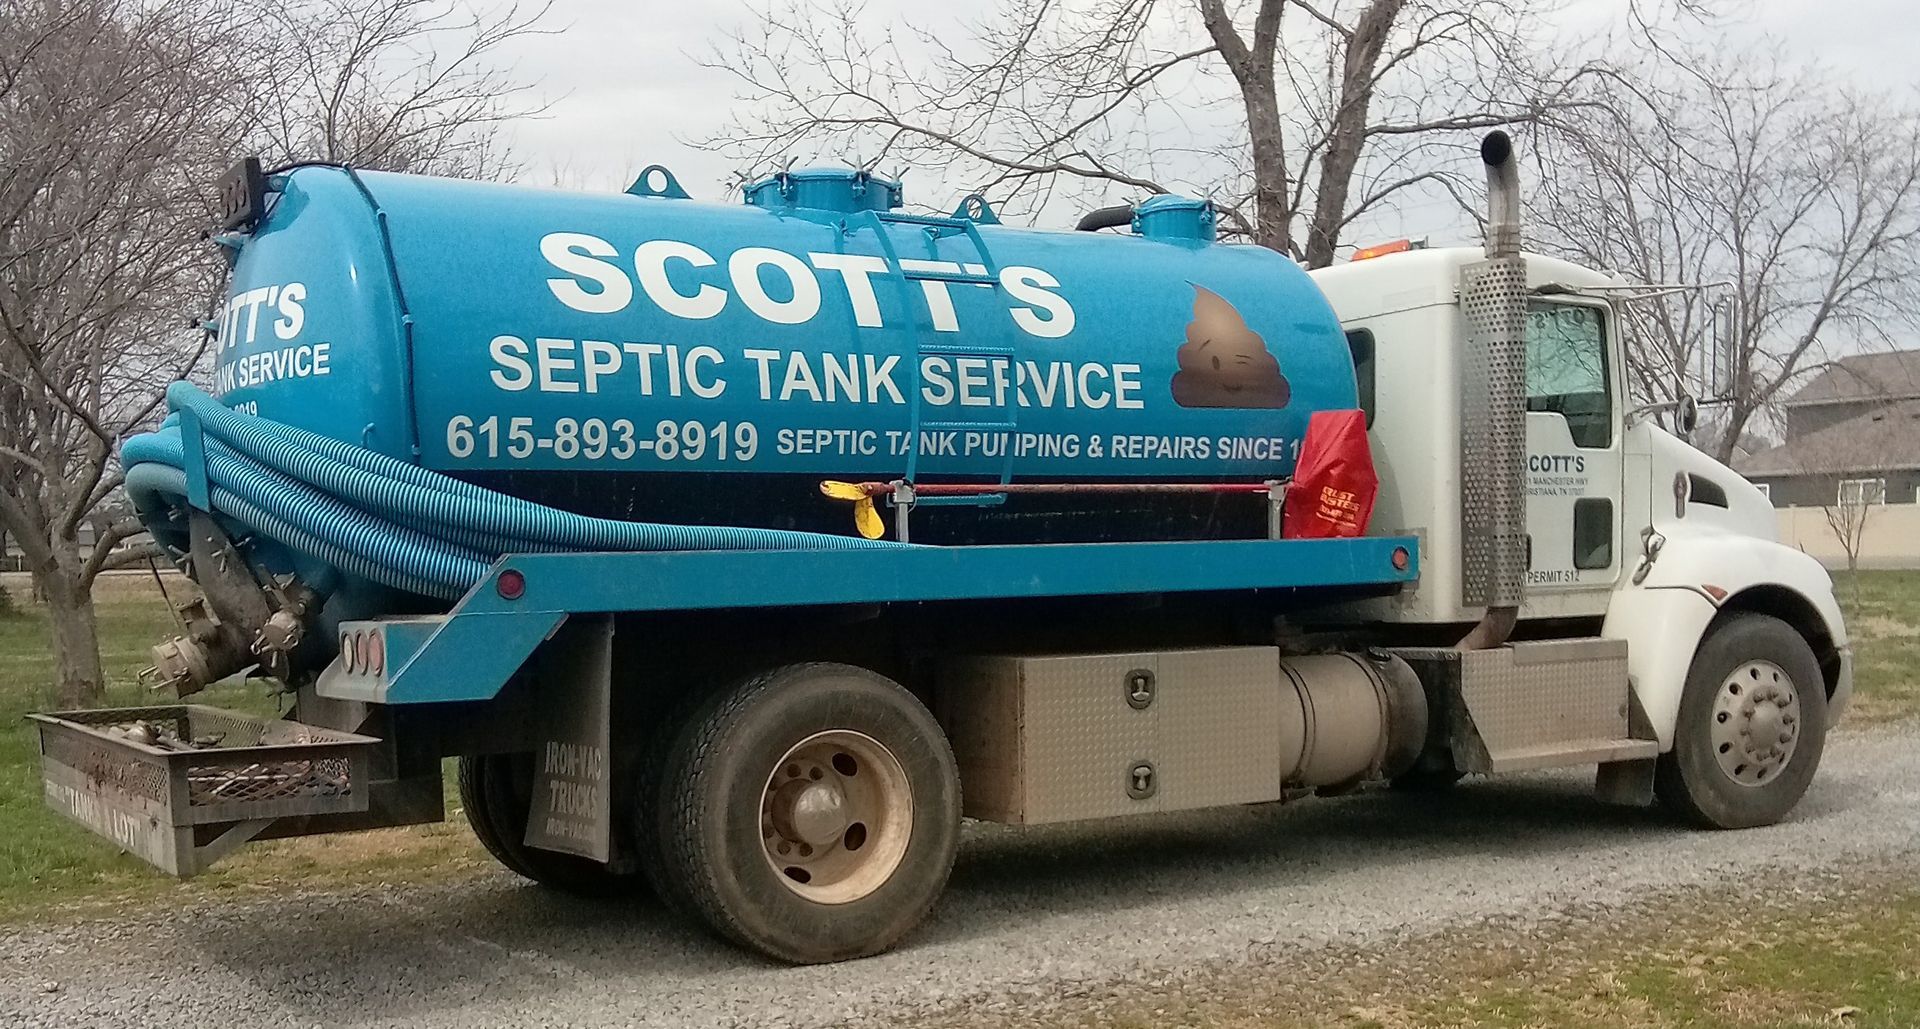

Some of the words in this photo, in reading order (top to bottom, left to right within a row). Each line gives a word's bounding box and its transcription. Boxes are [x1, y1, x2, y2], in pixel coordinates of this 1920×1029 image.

[540, 231, 1077, 339] SCOTT'S
[239, 342, 331, 388] SERVICE
[489, 335, 727, 399] SEPTIC
[743, 348, 906, 404] TANK
[920, 356, 1145, 410] SERVICE
[446, 414, 759, 461] 615-893-8919
[776, 428, 879, 456] SEPTIC
[1086, 434, 1104, 459] &
[1110, 434, 1211, 460] REPAIRS
[1216, 436, 1284, 461] SINCE
[1525, 454, 1585, 473] COTT'S
[1527, 570, 1562, 583] PERMIT
[1564, 569, 1580, 582] 512
[545, 741, 601, 781] IRON-VAC
[550, 779, 598, 819] TRUCKS
